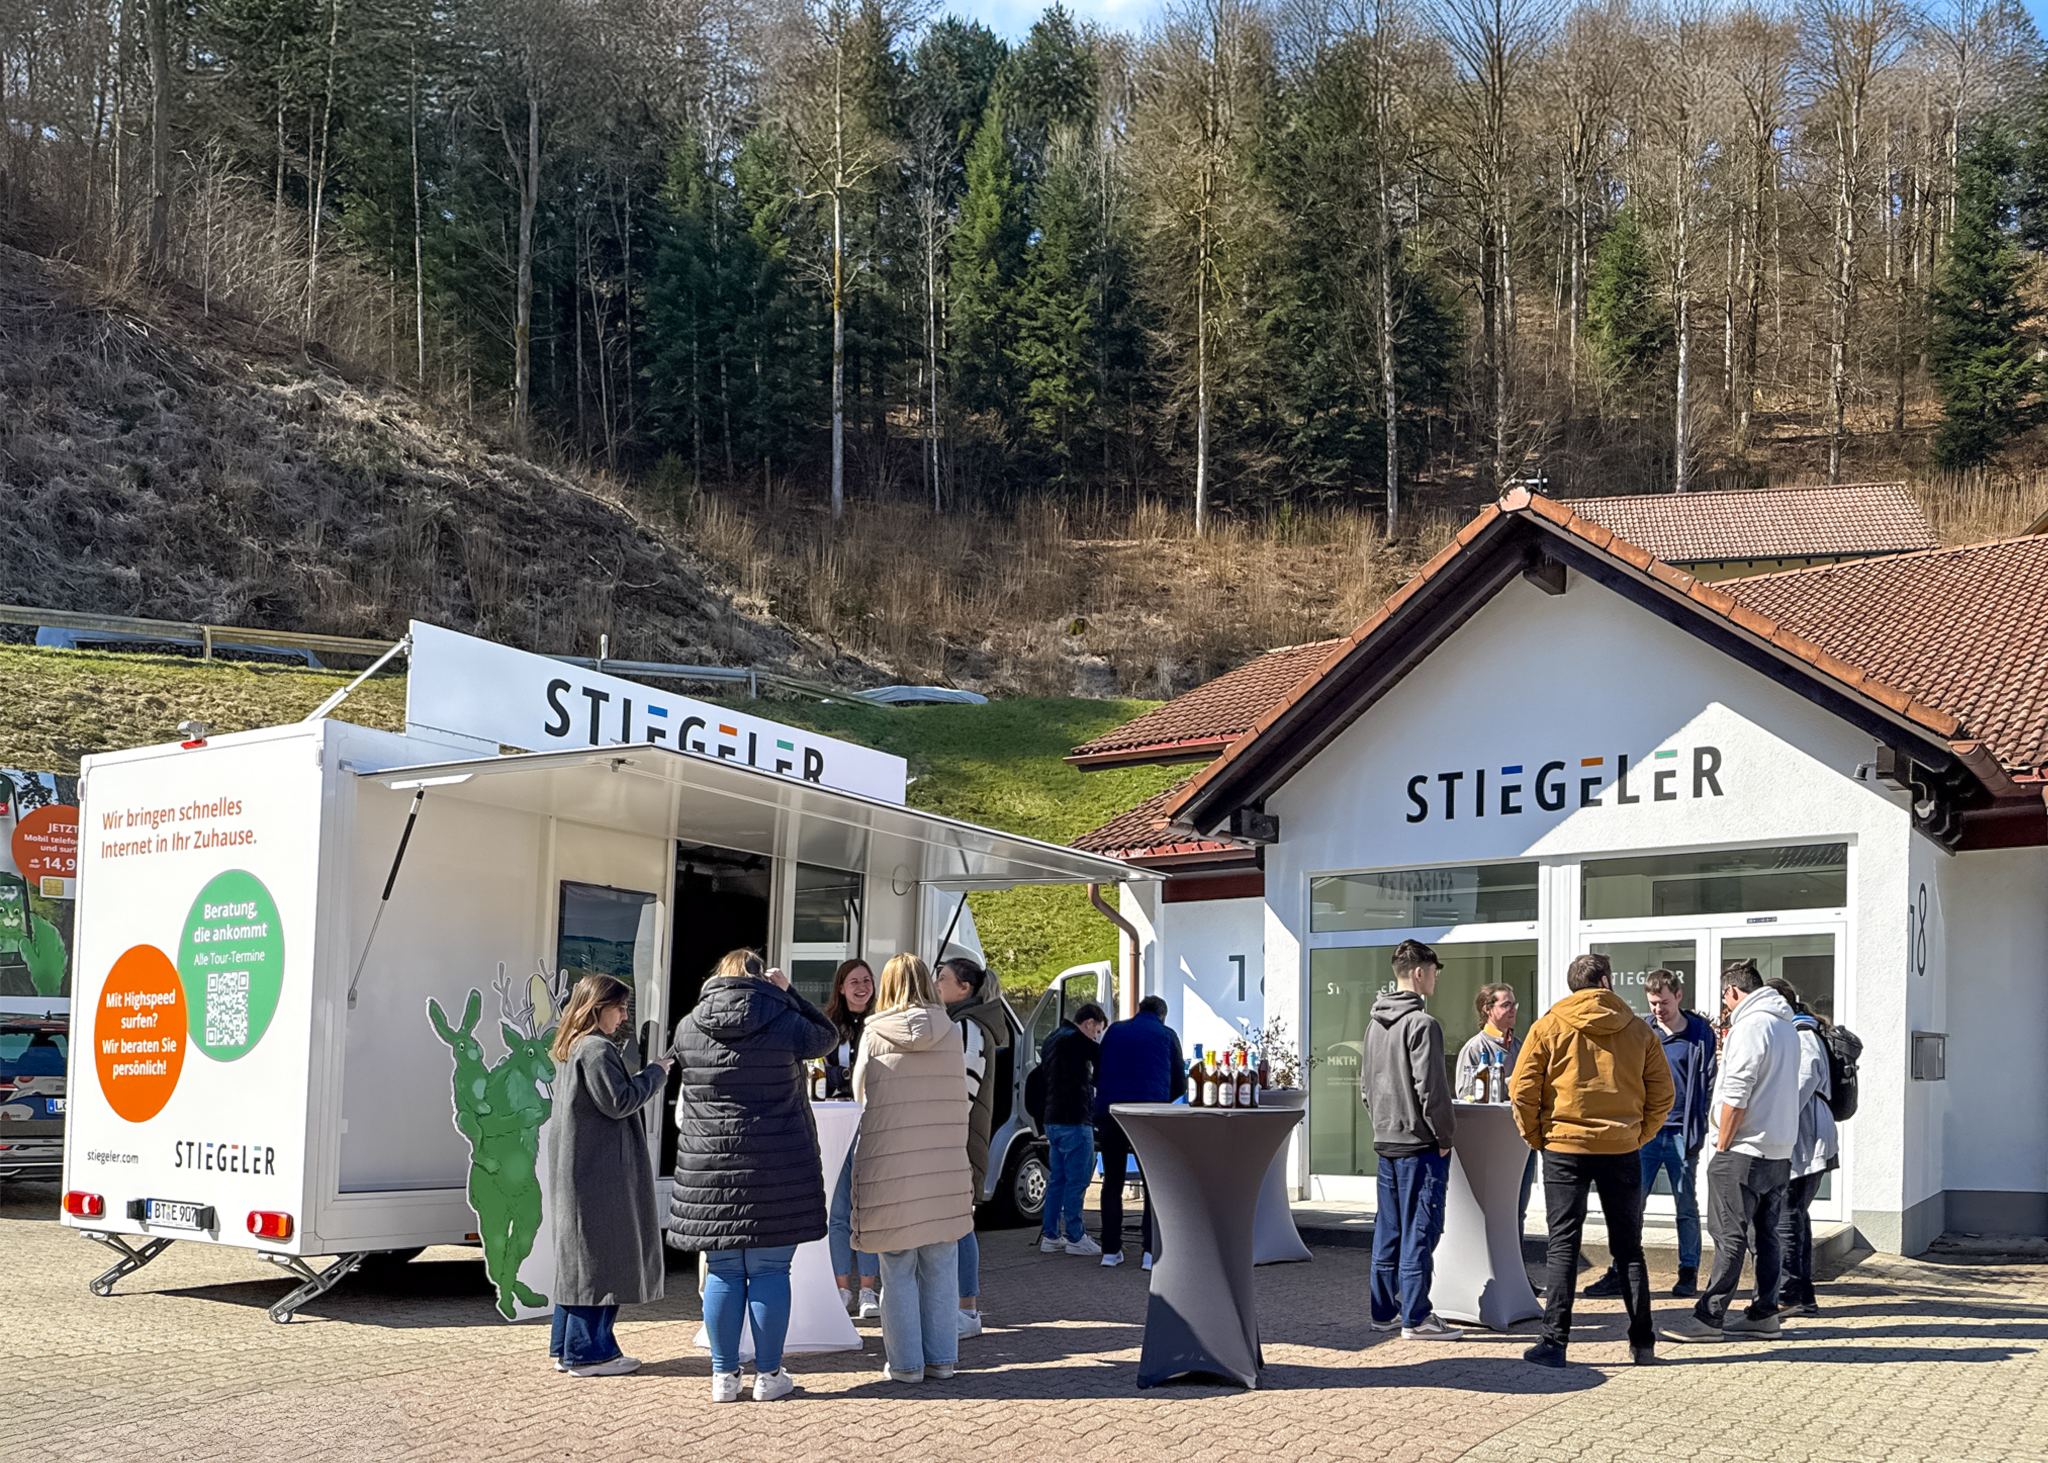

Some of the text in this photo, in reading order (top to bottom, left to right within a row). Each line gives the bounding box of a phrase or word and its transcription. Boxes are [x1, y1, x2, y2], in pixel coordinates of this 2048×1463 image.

[1405, 745, 1724, 823] STIEGELER
[102, 797, 243, 831] Wir bringen schnelles
[24, 833, 49, 843] Mobil
[101, 827, 258, 859] Internet in Ihr Zuhause.
[203, 900, 258, 920] Beratung,
[193, 922, 268, 944] die ankommt
[1910, 882, 1927, 977] 18
[193, 950, 265, 966] Alle Tour-Termine
[106, 988, 176, 1008] Mit Highspeed
[121, 1013, 158, 1029] surfen?
[102, 1037, 177, 1054] Wir beraten Sie
[112, 1059, 167, 1080] persönlich!
[1327, 1055, 1357, 1066] MKTH
[87, 1148, 139, 1165] stiegeler.com
[175, 1140, 275, 1175] STIEGELER
[155, 1202, 167, 1219] BT
[171, 1204, 177, 1221] E
